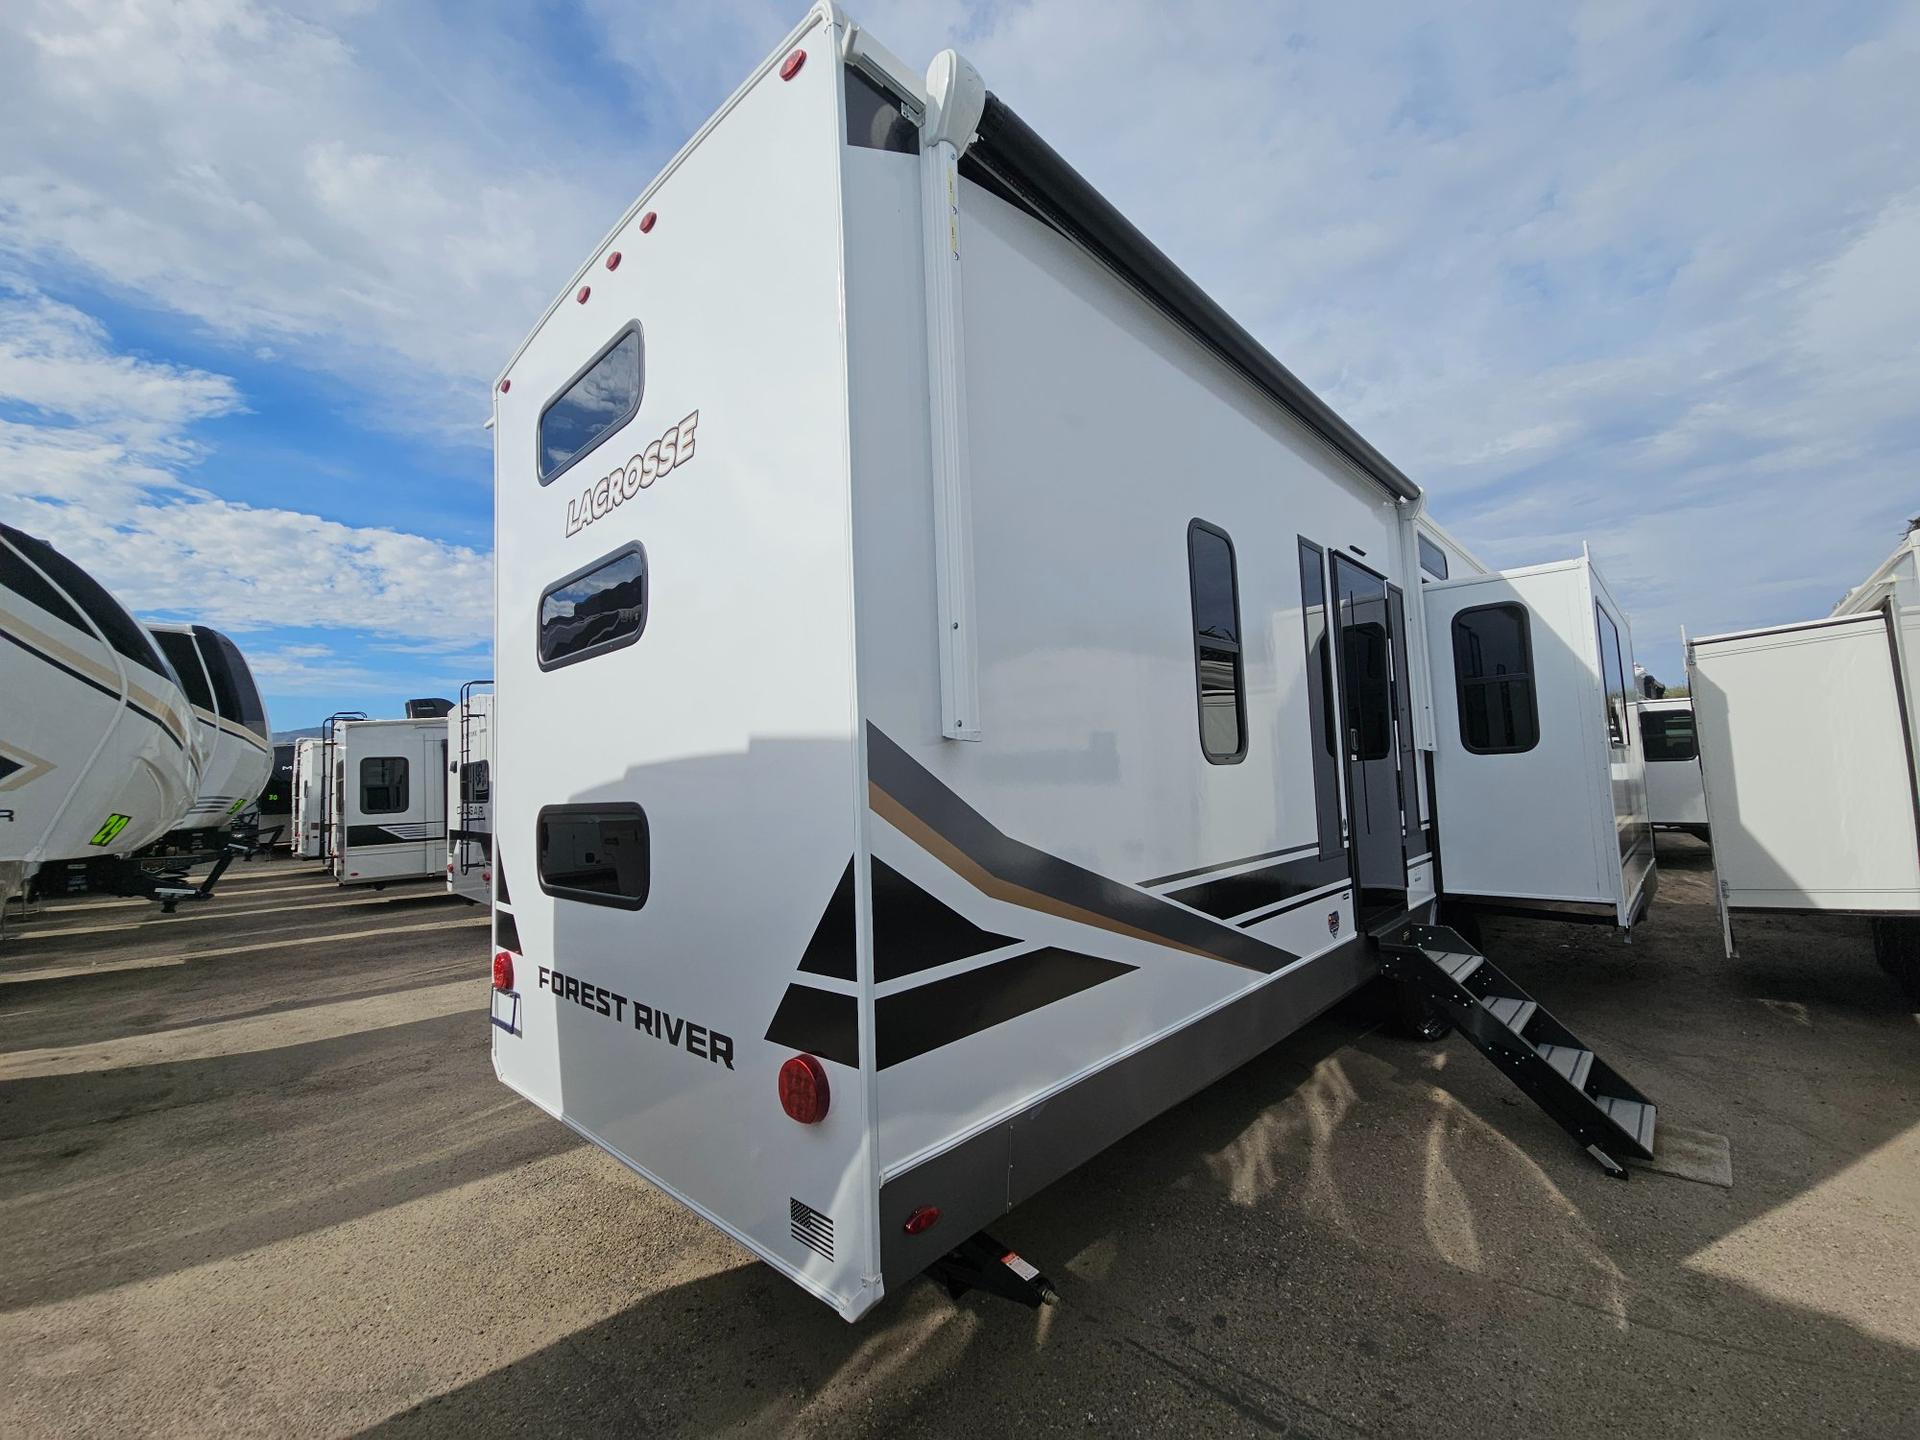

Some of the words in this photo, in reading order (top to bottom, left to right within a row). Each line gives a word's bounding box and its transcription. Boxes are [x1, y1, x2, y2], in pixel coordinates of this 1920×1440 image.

[566, 409, 699, 538] LACROSSE
[90, 814, 129, 845] 29
[538, 965, 628, 1023] FOREST
[633, 1000, 735, 1071] RIVER
